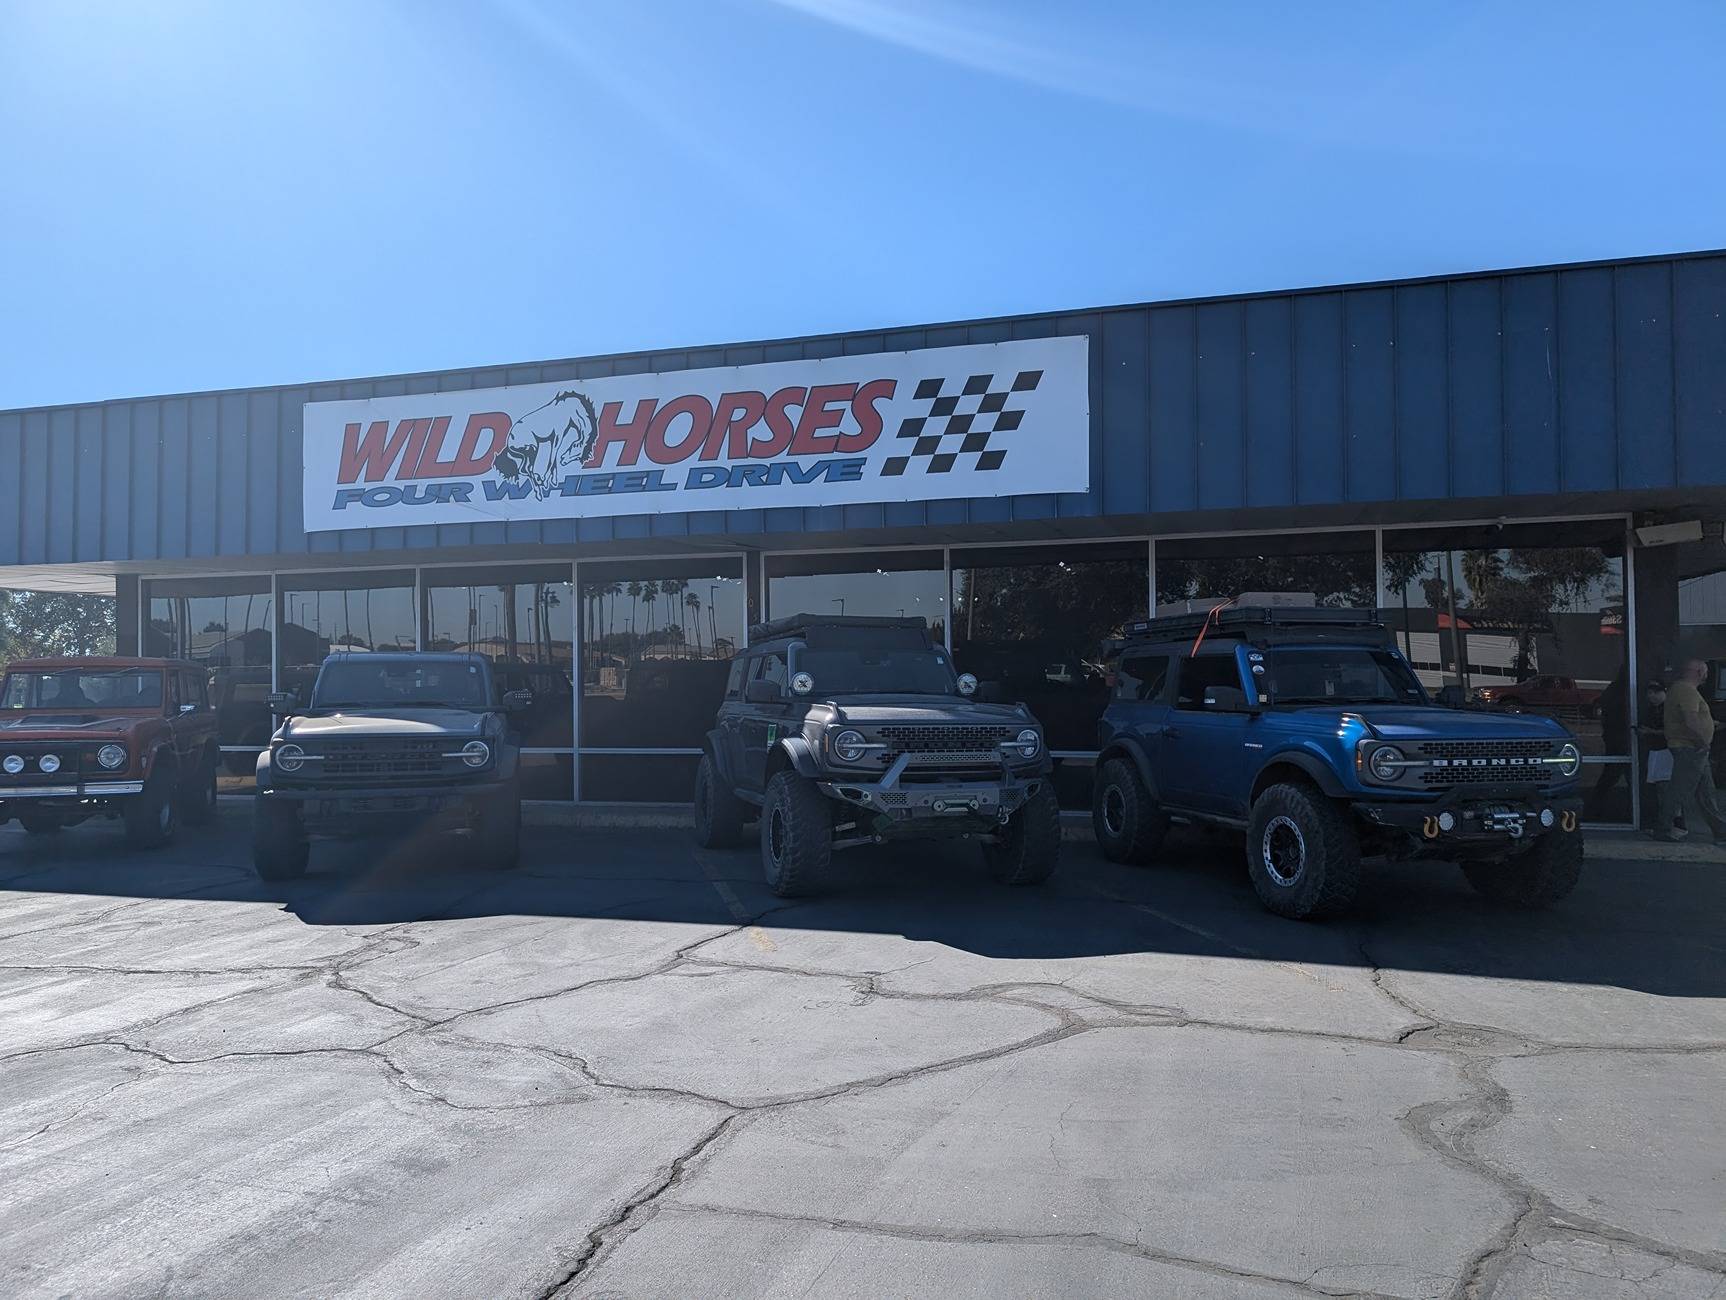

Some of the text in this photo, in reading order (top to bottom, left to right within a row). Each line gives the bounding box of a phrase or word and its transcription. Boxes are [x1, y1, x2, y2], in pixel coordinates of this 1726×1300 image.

[336, 378, 898, 485] WILD HORSES
[332, 456, 867, 510] FOUR WHEEL DRIVE
[1433, 757, 1543, 767] BRONCO
